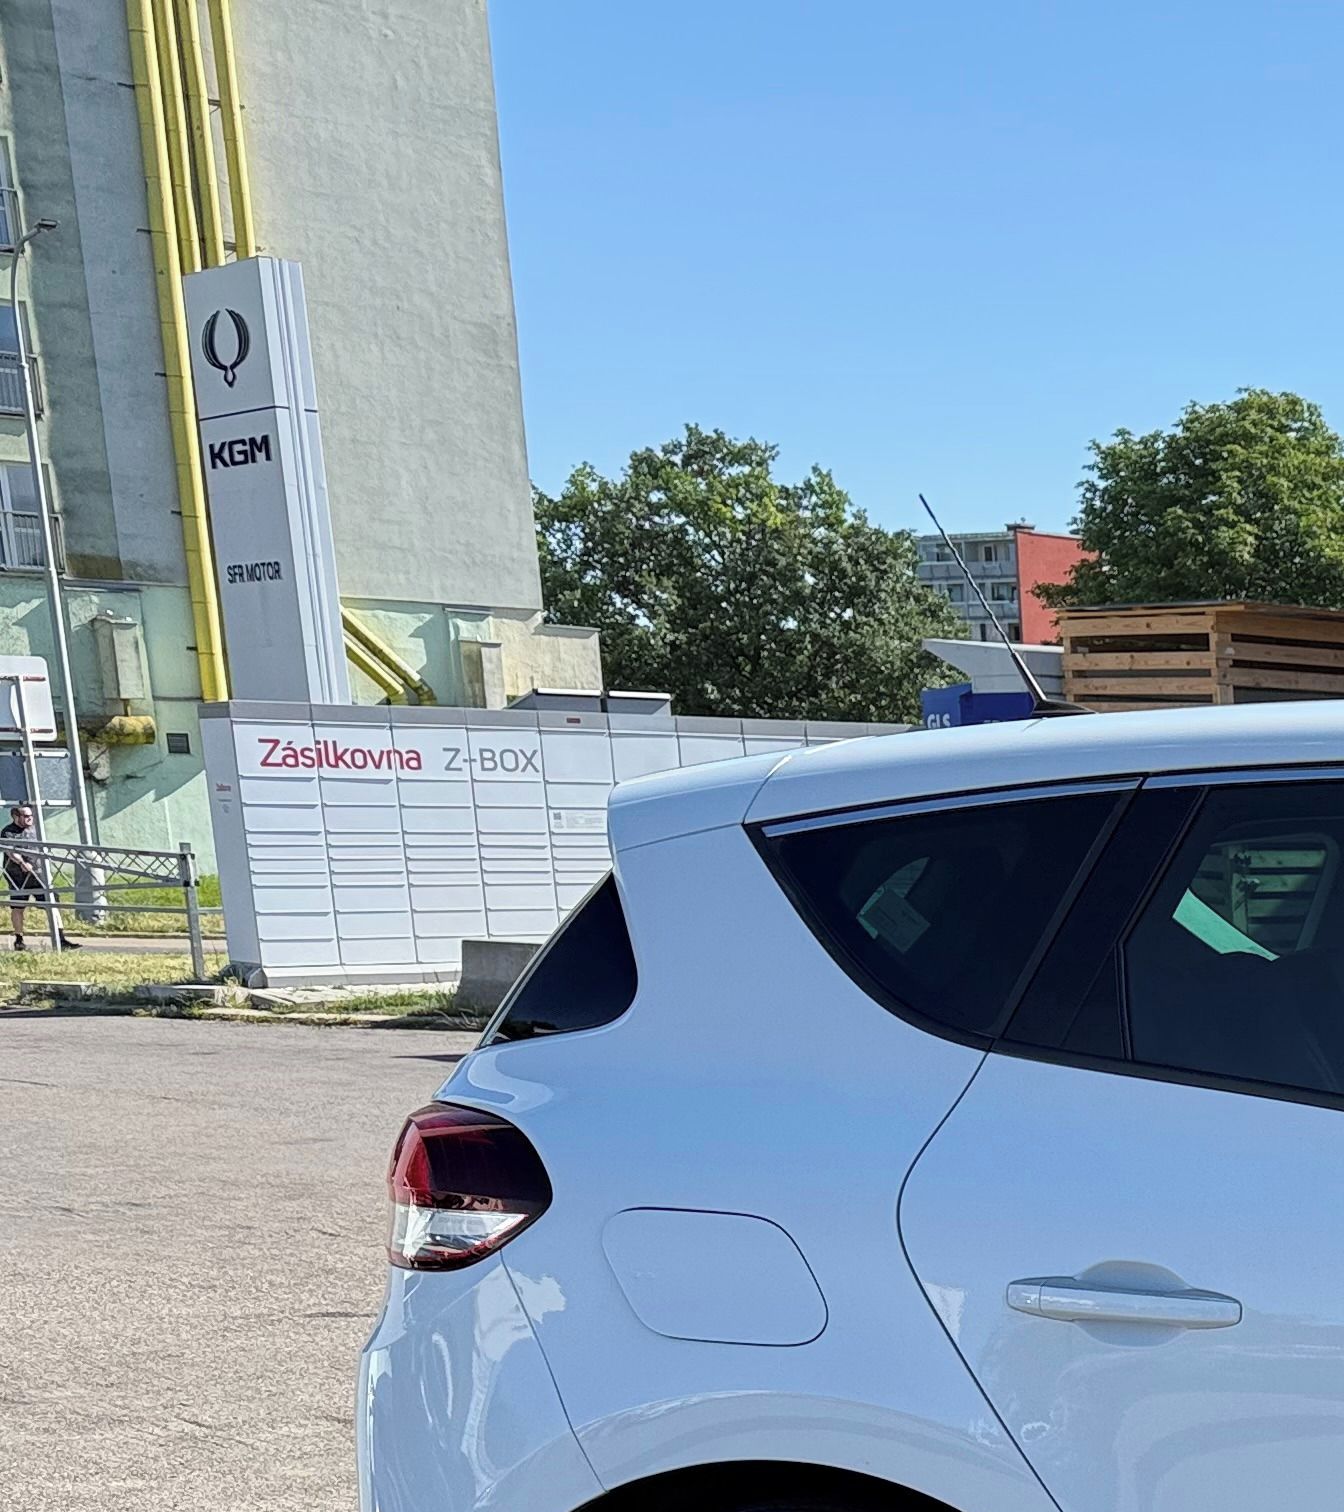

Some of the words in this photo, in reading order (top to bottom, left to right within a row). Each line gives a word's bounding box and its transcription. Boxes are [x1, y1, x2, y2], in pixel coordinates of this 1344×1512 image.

[209, 434, 272, 469] KGM
[227, 565, 245, 584] SFR
[245, 561, 283, 582] MOTOR
[258, 738, 422, 770] Zásilkovna
[442, 747, 540, 773] Z-BOX
